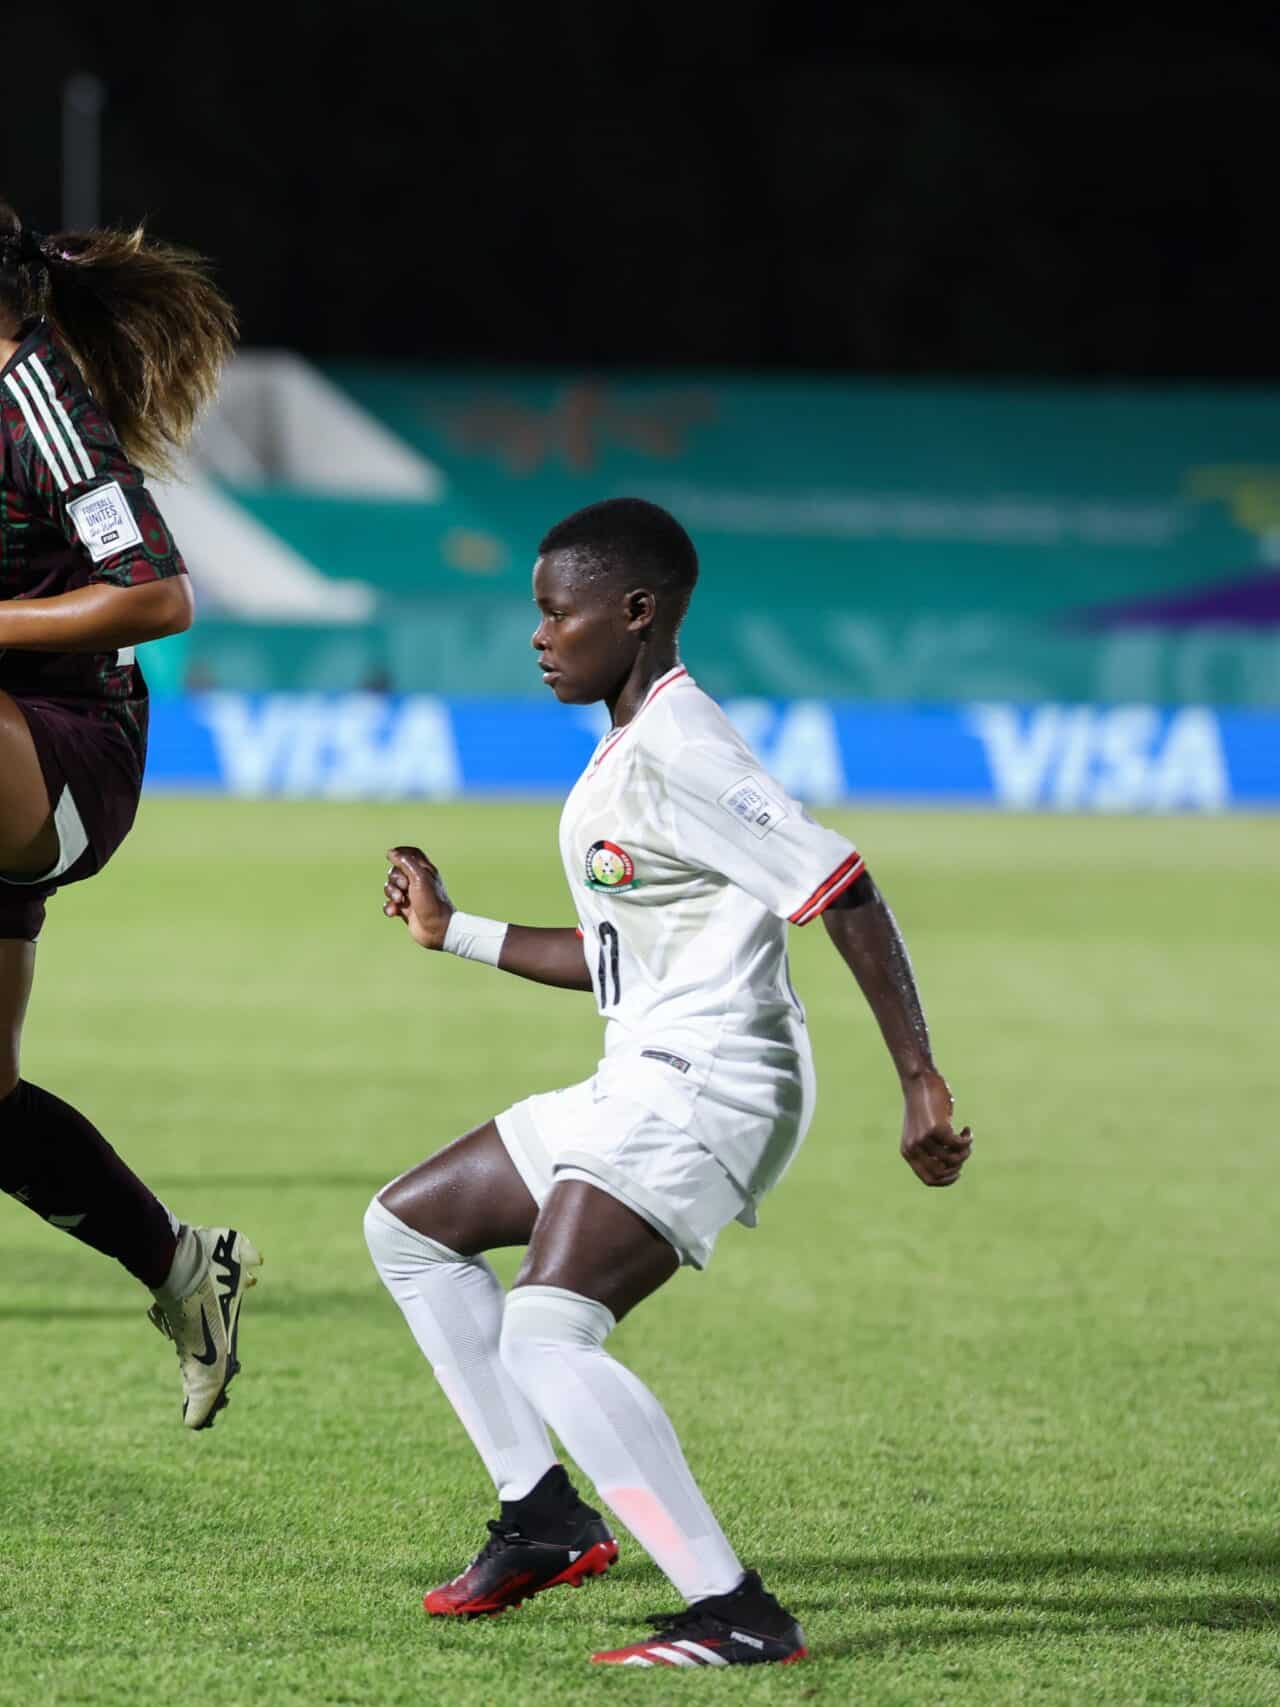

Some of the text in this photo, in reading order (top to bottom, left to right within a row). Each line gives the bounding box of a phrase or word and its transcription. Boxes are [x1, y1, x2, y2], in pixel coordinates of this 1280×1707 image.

[86, 505, 118, 527] UNITES
[200, 693, 464, 803] VISA
[963, 702, 1233, 816] VISA
